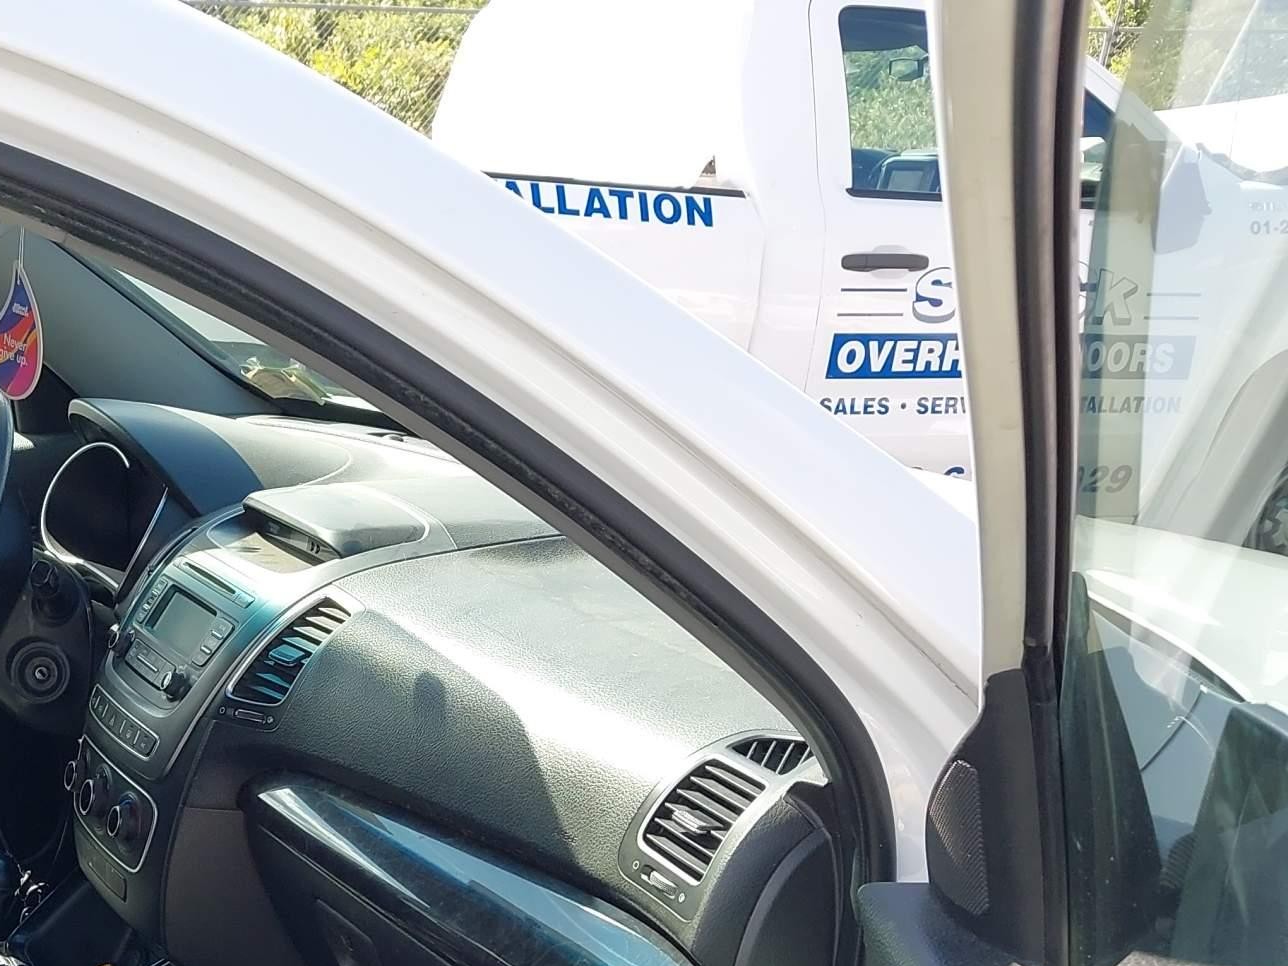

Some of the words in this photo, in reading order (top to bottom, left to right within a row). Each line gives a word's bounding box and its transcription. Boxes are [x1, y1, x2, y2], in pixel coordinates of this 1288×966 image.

[912, 266, 956, 323] S
[4, 333, 27, 351] Never
[0, 347, 15, 361] give
[16, 353, 28, 368] up.
[837, 340, 961, 373] OVERH
[1086, 341, 1175, 373] OORS
[819, 397, 890, 415] SALES
[1080, 396, 1183, 413] TALLATION
